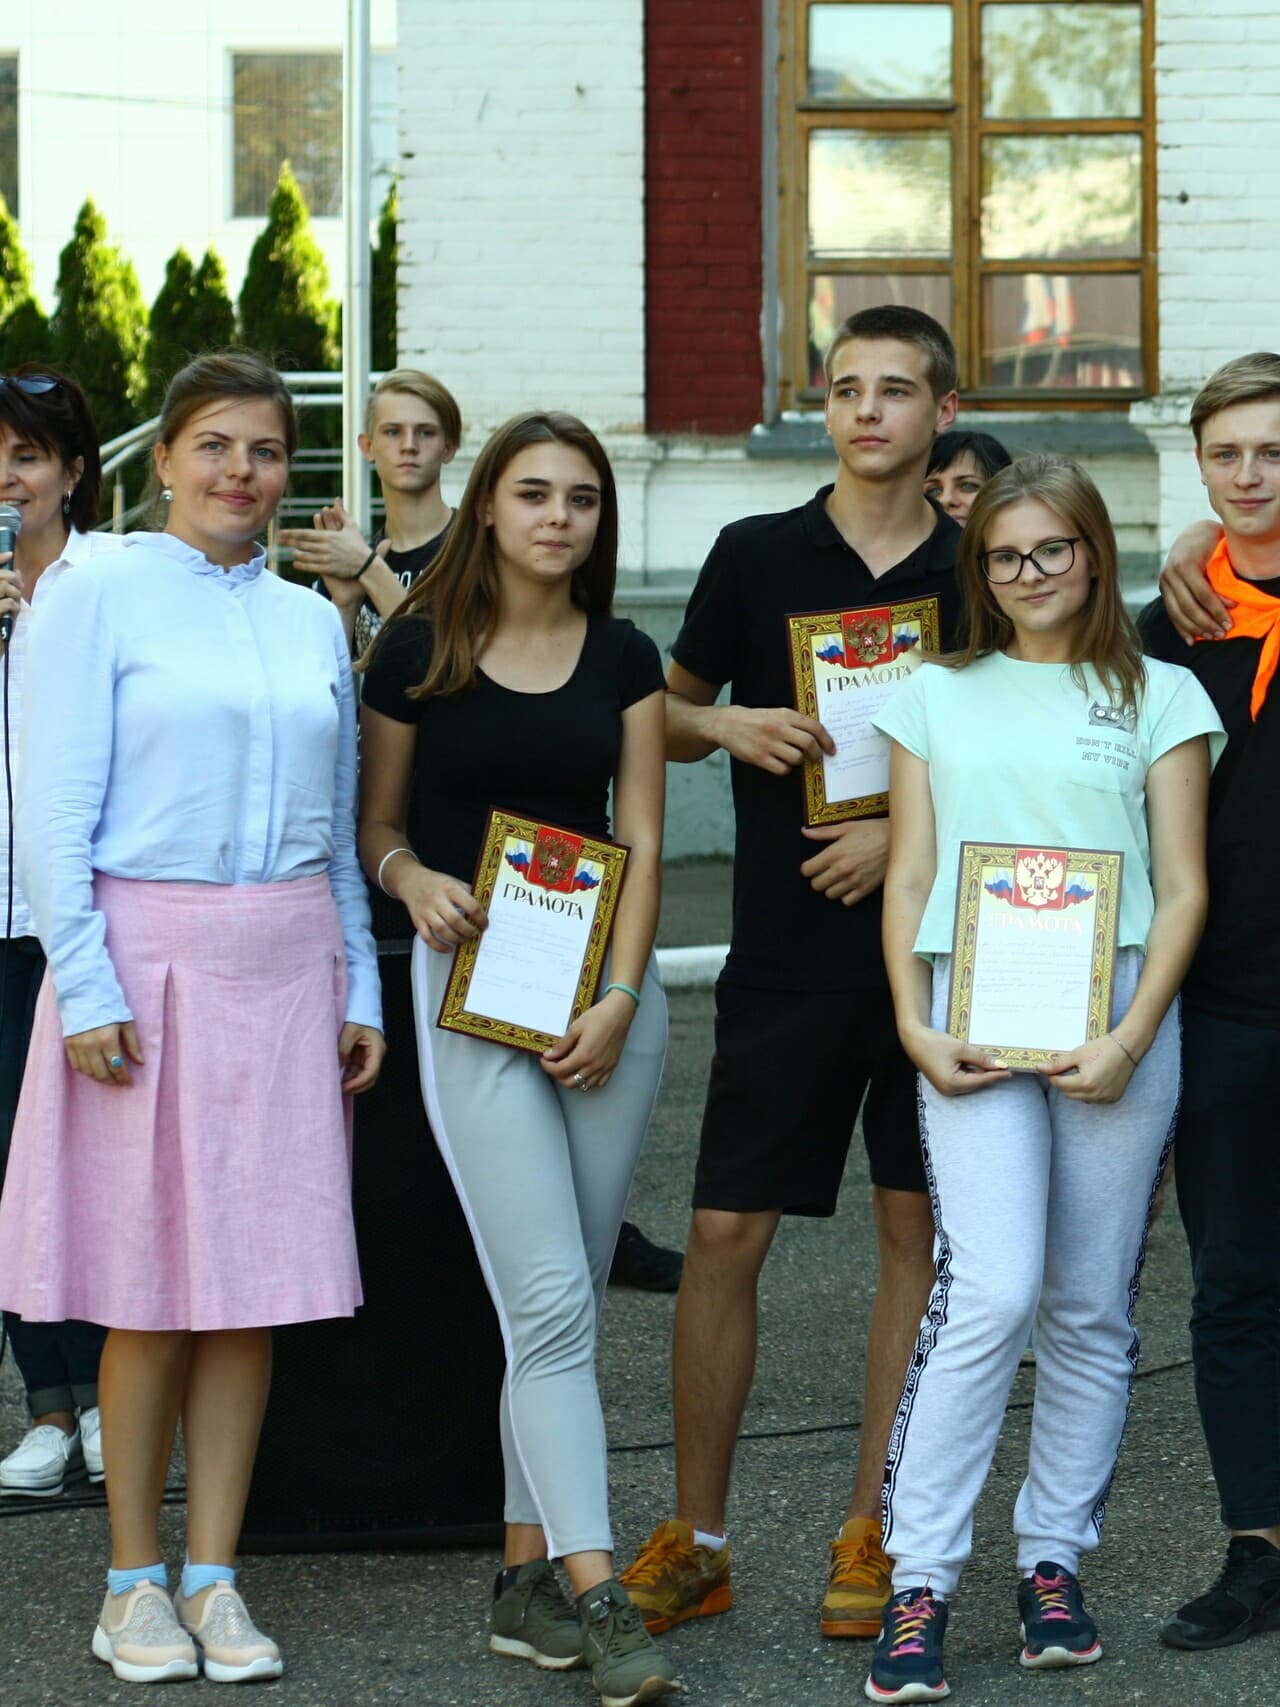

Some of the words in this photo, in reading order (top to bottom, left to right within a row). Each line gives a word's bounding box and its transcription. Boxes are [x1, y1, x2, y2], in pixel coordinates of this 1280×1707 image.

[825, 664, 913, 693] ГРАМОТА
[502, 882, 584, 921] ГРАМОТА
[989, 911, 1084, 934] ГРАМОТА
[908, 1366, 920, 1390] YOU
[887, 1414, 906, 1462] NUMBER
